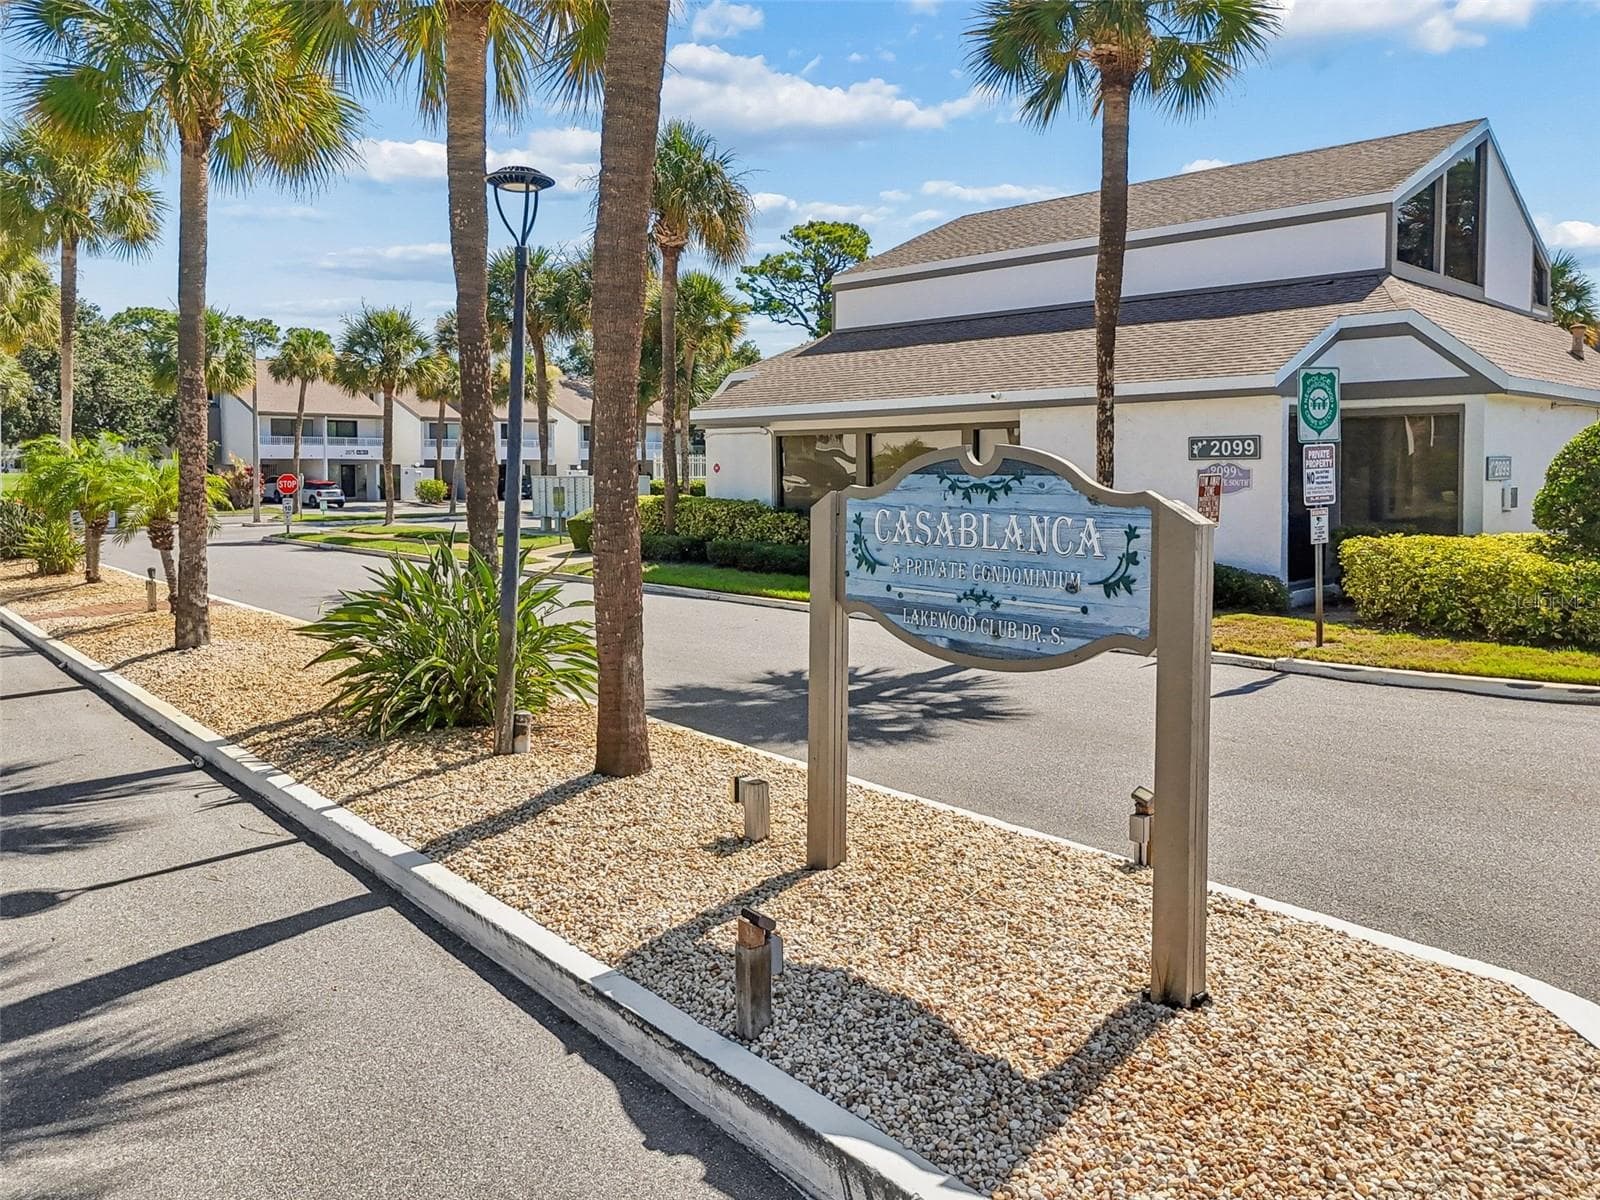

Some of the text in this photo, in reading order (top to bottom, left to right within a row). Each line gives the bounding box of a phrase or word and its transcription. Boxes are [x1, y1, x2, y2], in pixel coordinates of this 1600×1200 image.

[1210, 439, 1255, 456] 2099
[1308, 449, 1331, 459] PRIVATE
[1306, 459, 1332, 468] PROPERTY
[278, 480, 297, 489] STOP
[1307, 472, 1315, 485] NO
[874, 508, 1106, 560] CASABLANCA
[892, 557, 1082, 591] A PRIVATE CONDOMINIUM
[902, 607, 1065, 645] LAKEWOOD CLUB DR. S.
